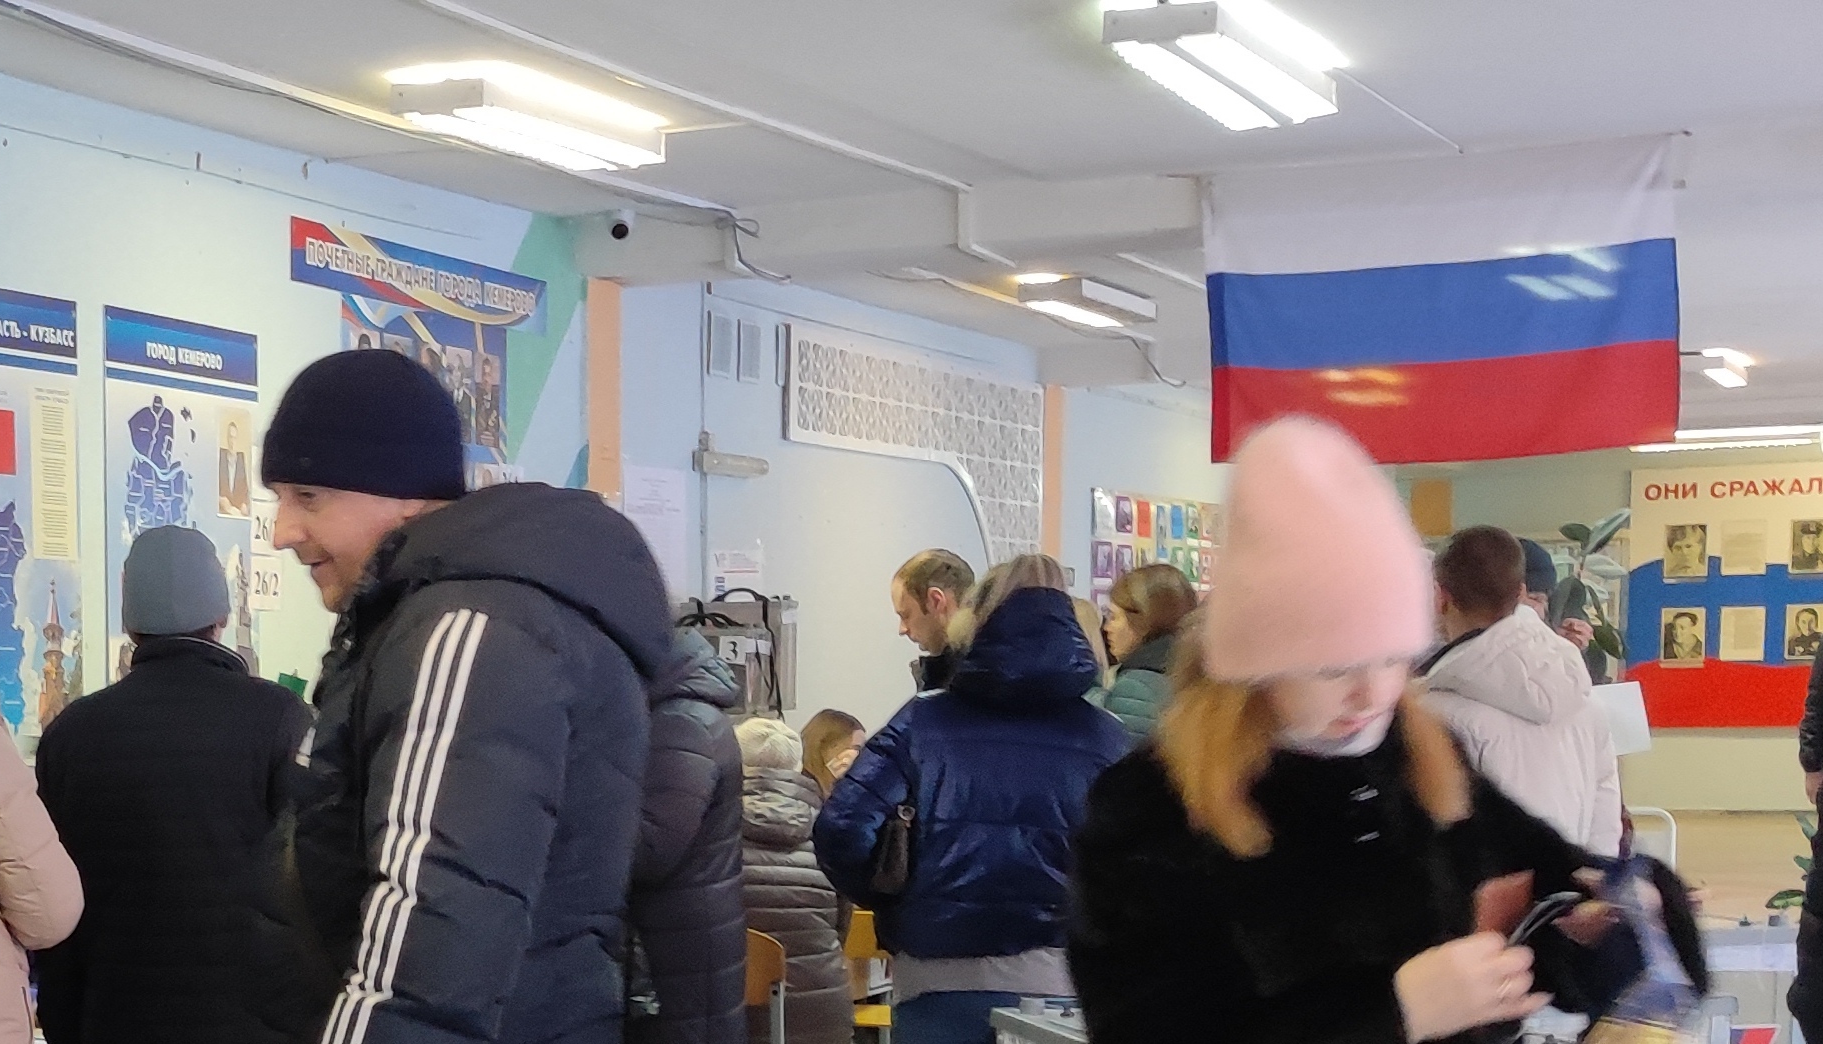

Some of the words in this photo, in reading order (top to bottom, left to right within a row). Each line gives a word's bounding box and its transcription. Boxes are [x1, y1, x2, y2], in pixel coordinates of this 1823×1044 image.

[438, 270, 483, 308] ГОРОДА
[484, 281, 536, 316] КЕМЕРОВО
[29, 324, 75, 348] КУЗБАСС
[145, 341, 177, 365] ГОРОД
[177, 346, 224, 371] КЕМЕРОВО
[1644, 482, 1698, 501] ОНИ
[1710, 477, 1823, 499] СРАЖАЛ
[724, 639, 739, 662] 3
